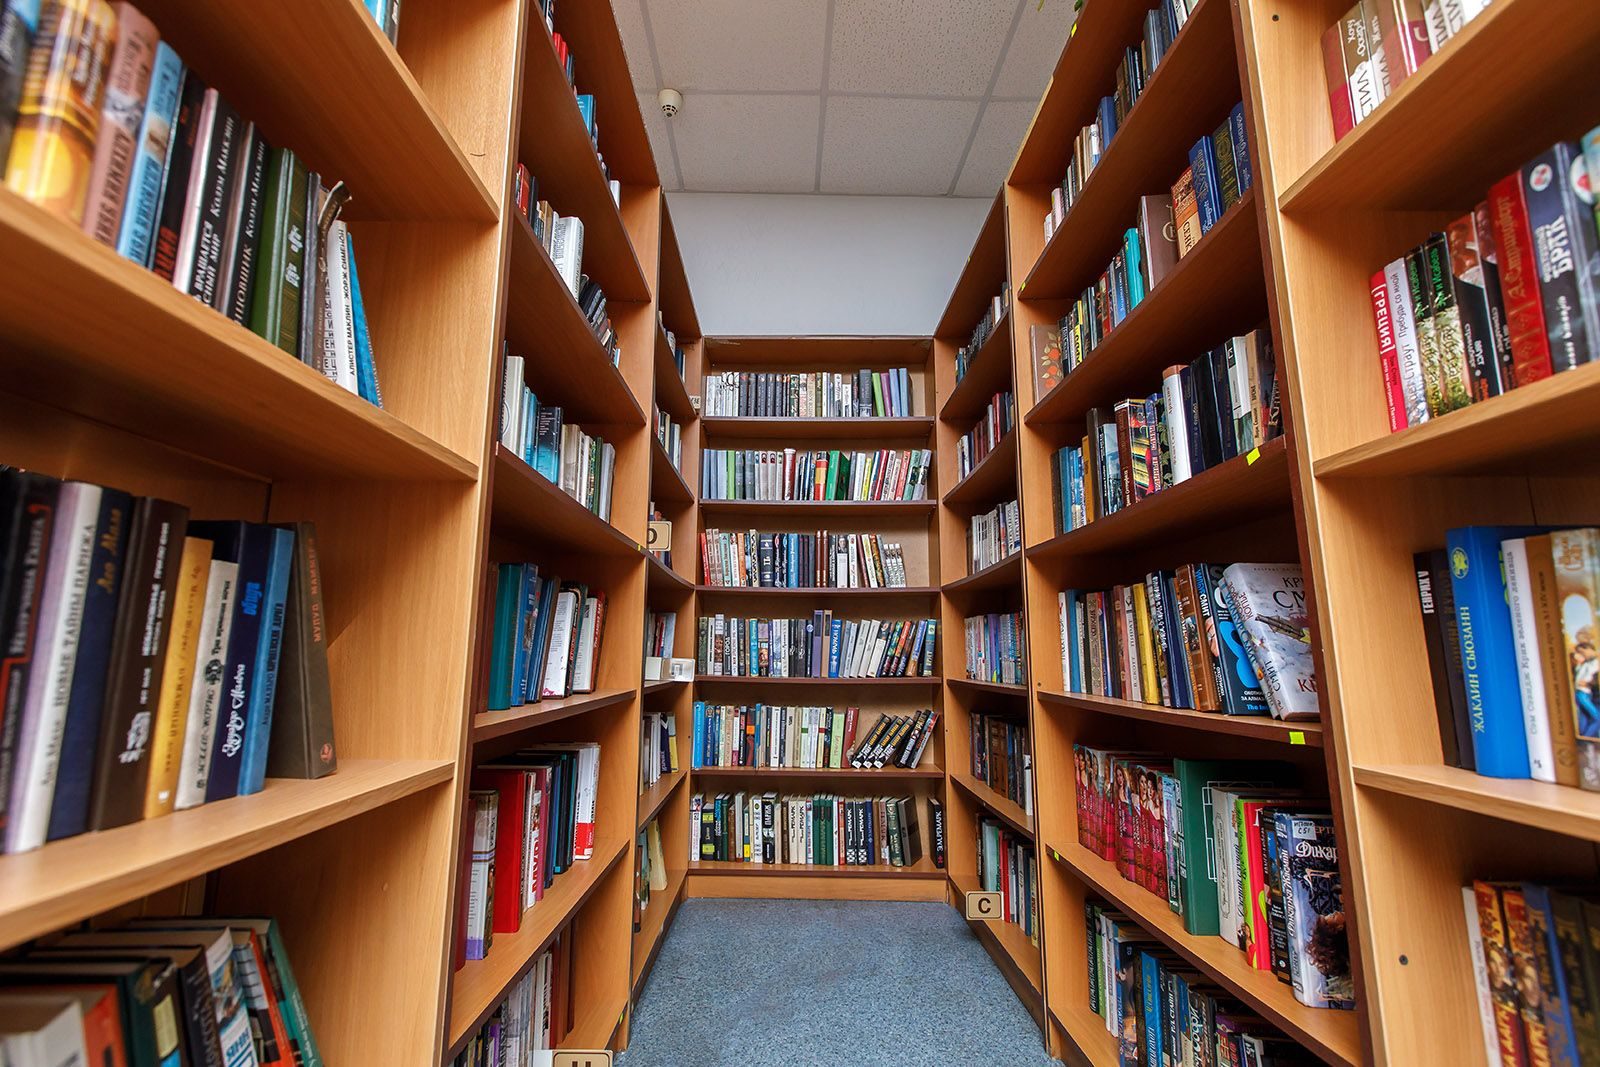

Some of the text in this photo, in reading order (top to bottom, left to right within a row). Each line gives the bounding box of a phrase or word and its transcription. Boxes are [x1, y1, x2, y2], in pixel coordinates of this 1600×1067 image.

[208, 233, 222, 262] МИР
[338, 228, 346, 268] СИМЕНОН
[1428, 248, 1441, 282] Исабель
[1408, 261, 1420, 292] Исабель
[1389, 271, 1409, 337] Пребудь со мной
[347, 339, 355, 375] АЛИСТЕР
[1398, 342, 1418, 378] Страут
[1200, 594, 1209, 617] СМИТ
[1417, 568, 1437, 614] ГЕНРИХ V
[53, 522, 94, 706] НОВЫЕ ТАЙНЫ ПАРИЖА
[1512, 596, 1524, 639] зеленого
[1458, 605, 1486, 733] ЖАКЛИН СЬЮЗАНН
[1518, 642, 1528, 669] Крик
[1265, 660, 1281, 691] СМИТ
[220, 709, 246, 758] Эдуардо
[978, 897, 991, 914] С
[1279, 847, 1296, 935] Дикарка Жасмин
